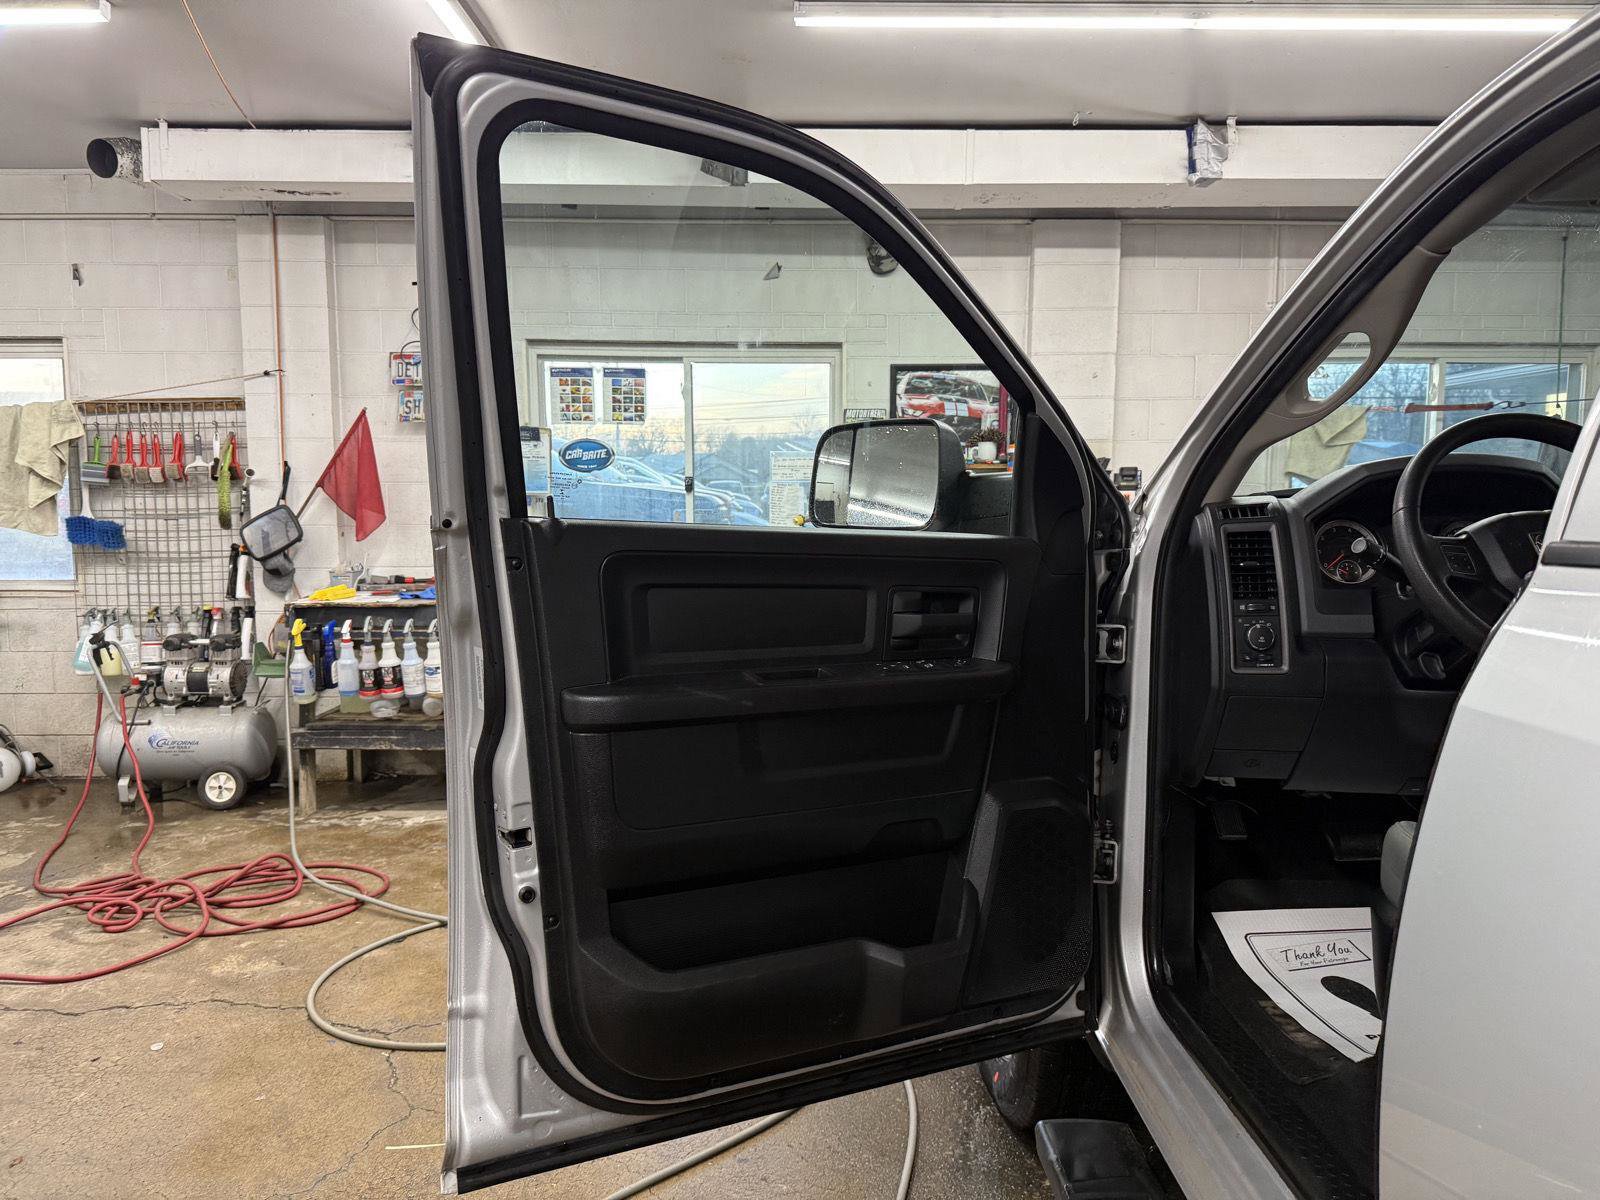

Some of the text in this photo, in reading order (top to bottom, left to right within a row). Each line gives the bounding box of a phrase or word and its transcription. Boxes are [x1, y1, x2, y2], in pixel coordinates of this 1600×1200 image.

[565, 448, 609, 461] CAR BRITE
[156, 738, 199, 748] CALIFORNIA
[1280, 942, 1352, 963] Thank You
